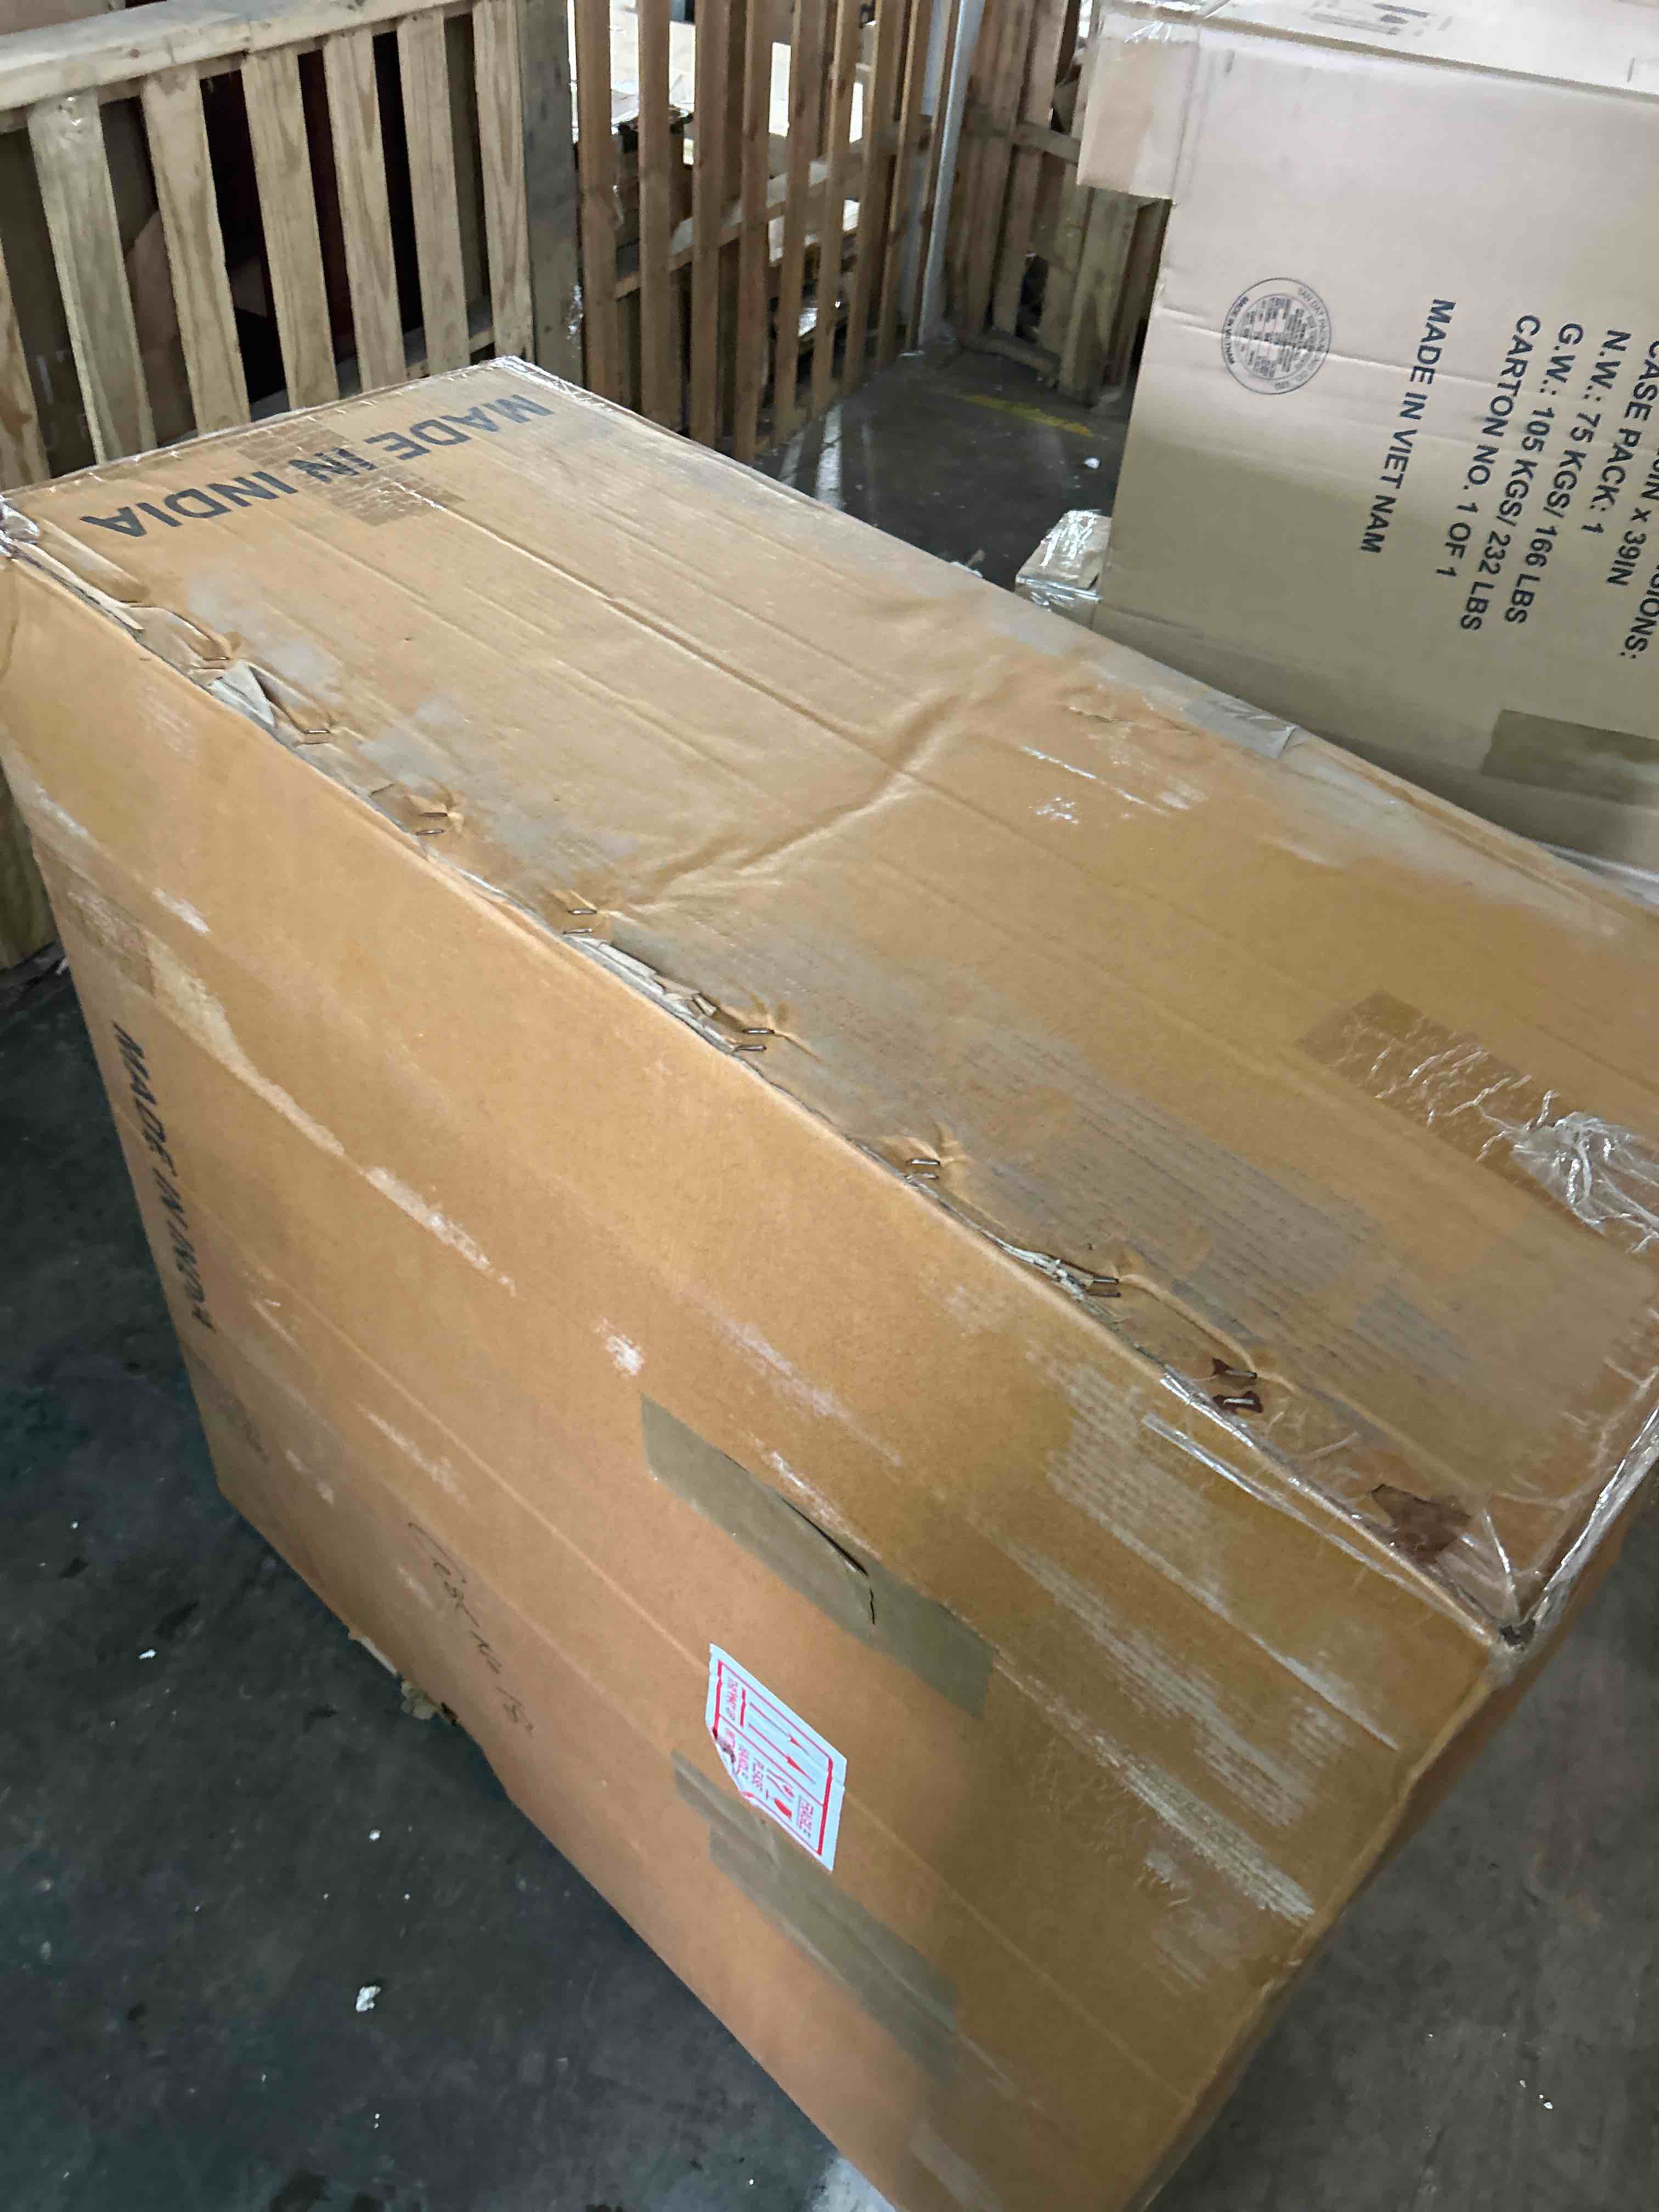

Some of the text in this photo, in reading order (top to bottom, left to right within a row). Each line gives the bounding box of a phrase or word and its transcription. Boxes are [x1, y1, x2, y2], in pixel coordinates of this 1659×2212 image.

[79, 393, 556, 538] MADE IN INDIA
[1360, 298, 1457, 554] MADE IN VIET NAM
[1435, 314, 1542, 578] CARTON NO. 1 OF 1
[1459, 322, 1584, 632] G.W.: 105 KGS/ 232 LBS
[1503, 329, 1632, 624] N.W.: 75 KGS/ 166 LBS
[1580, 522, 1605, 533] 1
[1589, 428, 1643, 512] PACK:
[1606, 530, 1647, 586] 39IN
[112, 1019, 217, 1334] MADE IN INDIA
